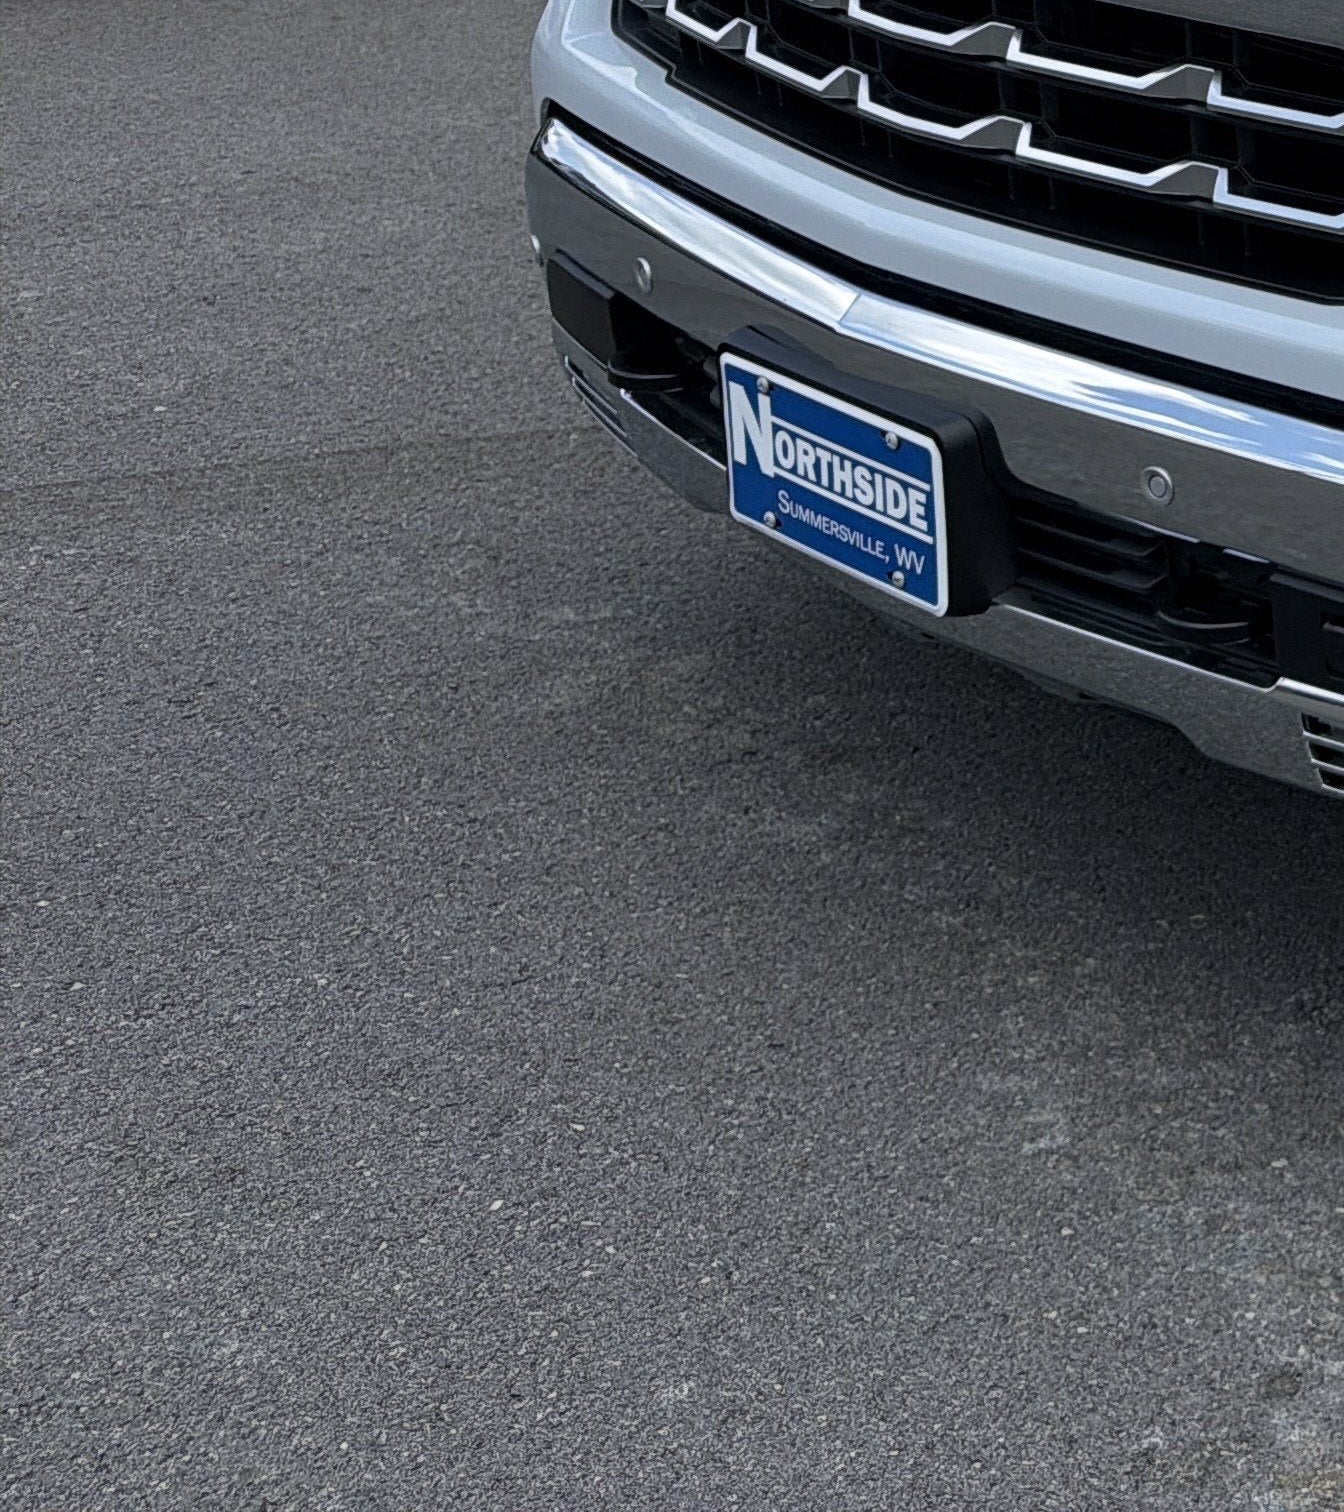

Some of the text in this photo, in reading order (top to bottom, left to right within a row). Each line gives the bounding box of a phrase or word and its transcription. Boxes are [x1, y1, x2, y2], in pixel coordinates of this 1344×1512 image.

[728, 380, 930, 533] NORTHSIDE
[777, 489, 925, 575] SUMMERSVILLE, WV
